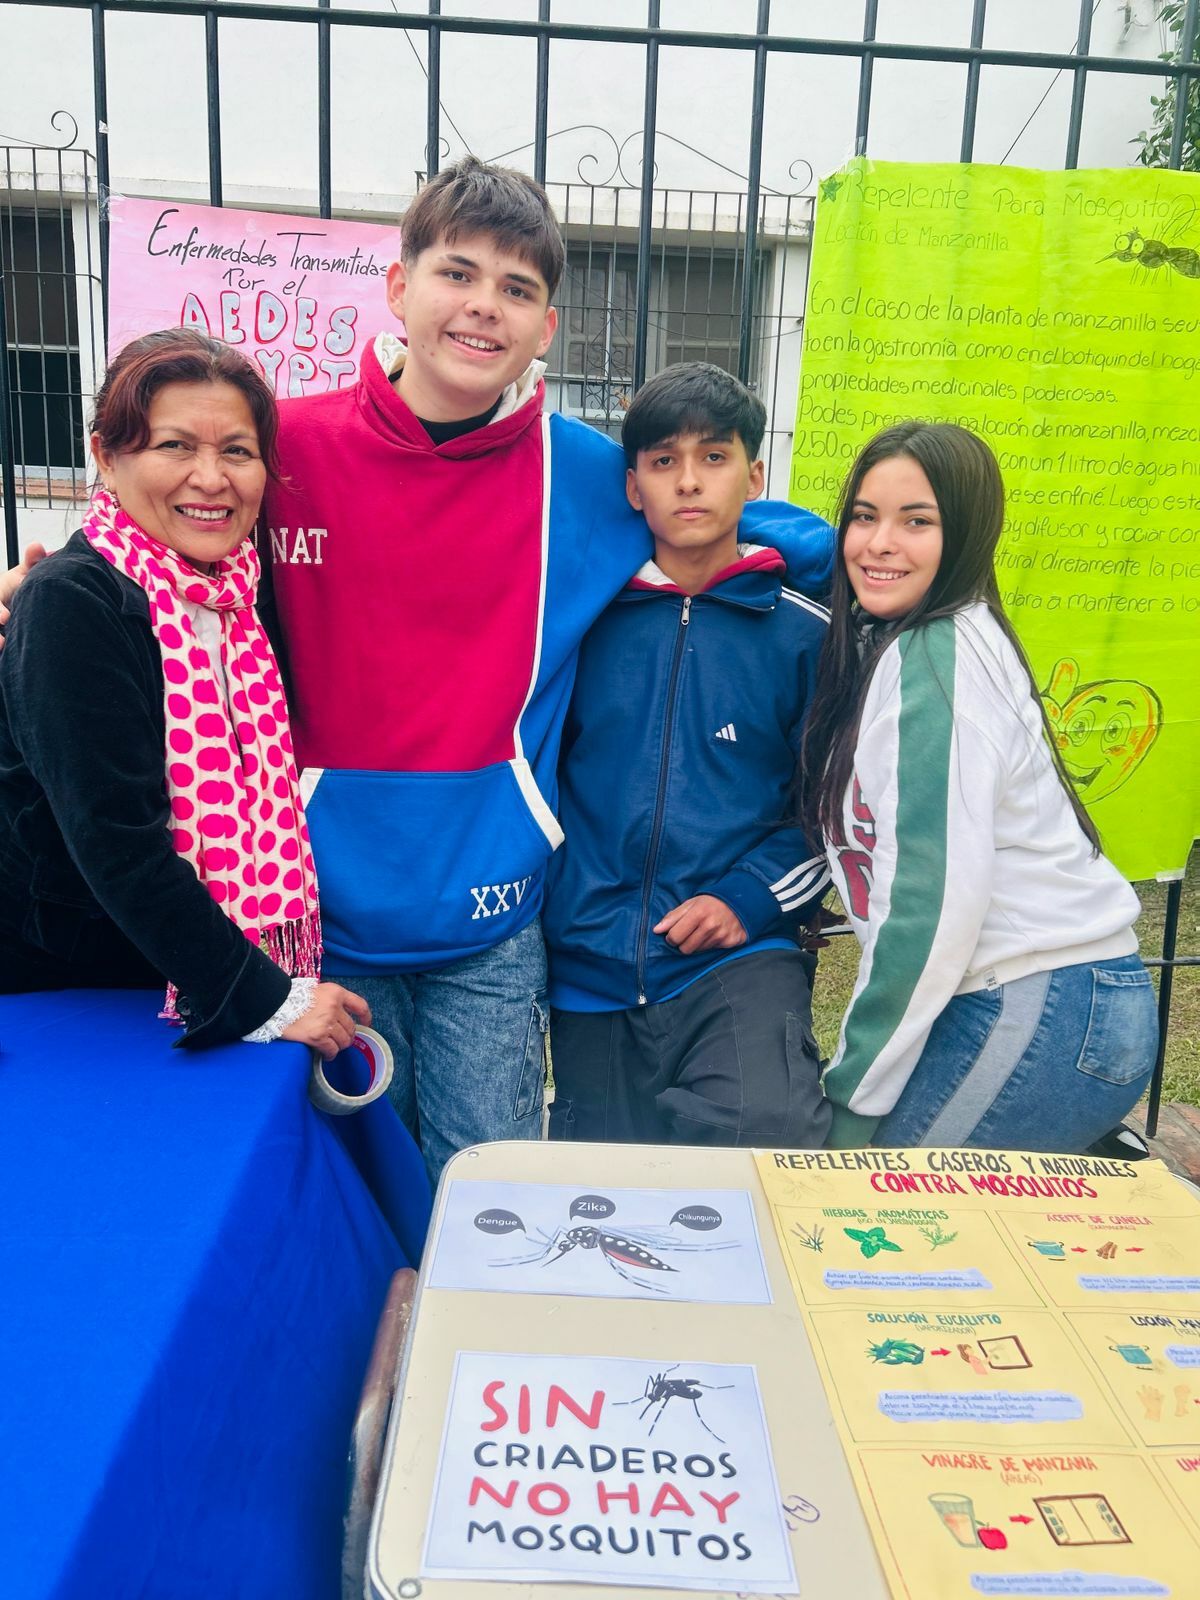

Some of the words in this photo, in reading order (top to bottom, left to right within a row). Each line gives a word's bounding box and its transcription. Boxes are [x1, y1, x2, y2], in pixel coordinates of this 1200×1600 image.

[845, 167, 970, 212] Repelente
[993, 188, 1045, 216] Para
[147, 208, 277, 267] Enfermedades
[277, 232, 388, 277] Transmitidas
[885, 218, 909, 245] de
[918, 224, 1009, 251] Manzanilla
[222, 268, 265, 291] Por
[283, 275, 307, 297] el
[811, 280, 836, 315] En
[841, 287, 862, 315] el
[865, 297, 911, 321] caso
[915, 294, 940, 321] de
[946, 295, 964, 321] la
[967, 303, 1022, 327] planta
[1026, 306, 1049, 328] de
[1053, 311, 1157, 331] manzanilla
[181, 291, 358, 356] AEDES
[863, 337, 957, 364] gastromía
[965, 344, 1013, 359] como
[801, 372, 910, 395] propiedades
[912, 376, 1017, 400] medicinales
[1023, 384, 1118, 405] poderosas.
[798, 394, 857, 426] Podes
[793, 429, 838, 458] 250
[999, 451, 1028, 471] con
[1029, 456, 1053, 472] un
[1058, 451, 1066, 473] 1
[1069, 454, 1105, 474] litro
[1133, 461, 1177, 487] agua
[1181, 459, 1200, 475] hi
[1109, 484, 1160, 516] Luego
[269, 527, 328, 565] NAT
[1025, 516, 1090, 537] difusor
[1096, 525, 1109, 548] y
[1113, 527, 1166, 543] rociar
[1041, 549, 1141, 577] diretamente
[1149, 555, 1165, 577] la
[1047, 596, 1061, 611] a
[1067, 592, 1158, 613] mantener
[1162, 597, 1175, 613] a
[1181, 594, 1200, 612] lo
[470, 875, 532, 920] XXV
[773, 1151, 911, 1172] REPELENTES
[927, 1151, 1012, 1174] CASEROS
[1021, 1155, 1036, 1175] Y
[1039, 1158, 1138, 1178] NATURALES
[870, 1172, 969, 1195] CONTRA
[968, 1174, 1098, 1199] MOSQUITOS
[477, 1217, 518, 1228] Dengue
[577, 1202, 607, 1213] Zika
[678, 1213, 720, 1223] Chikungunya
[822, 1208, 868, 1218] HIERBAS
[1046, 1213, 1084, 1223] ACEITE
[1089, 1215, 1103, 1224] DE
[1110, 1216, 1153, 1225] CANELA
[867, 1311, 929, 1324] SOLUCIÓN
[936, 1314, 1002, 1326] EUCALIPTO
[480, 1379, 606, 1434] SIN
[473, 1440, 738, 1478] CRIADEROS
[921, 1454, 992, 1470] VINAGRE
[999, 1457, 1020, 1472] DE
[1022, 1456, 1098, 1471] MANZANA
[468, 1475, 571, 1516] NO
[596, 1480, 741, 1524] HAY
[467, 1520, 753, 1561] MOSQUITOS
